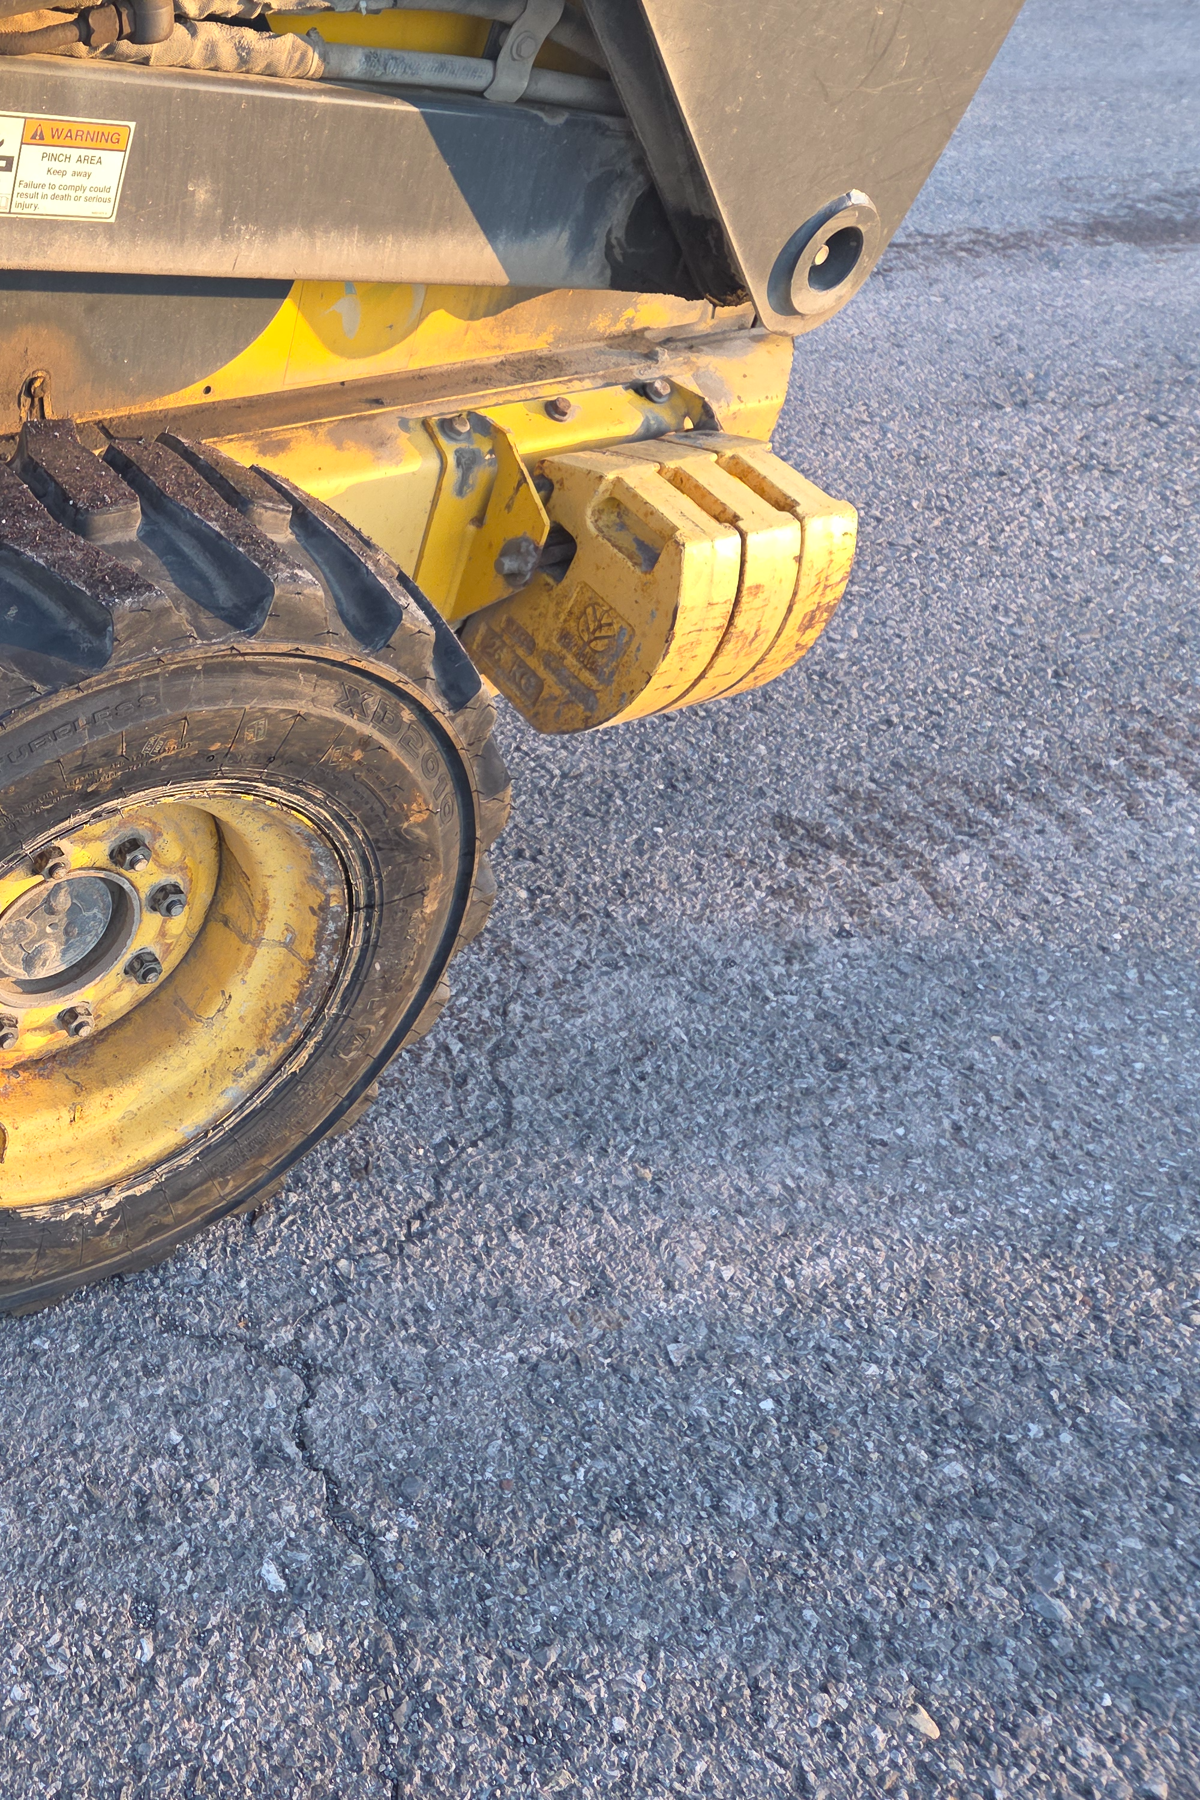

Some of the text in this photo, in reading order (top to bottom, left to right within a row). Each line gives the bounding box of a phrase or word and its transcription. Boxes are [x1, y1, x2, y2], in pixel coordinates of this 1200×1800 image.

[50, 127, 121, 145] WARNING
[41, 152, 103, 165] PINCH AREA
[46, 167, 92, 180] Keep away
[18, 180, 111, 194] Failure to comply could
[16, 191, 39, 200] result
[41, 192, 48, 200] in
[50, 193, 72, 201] death
[84, 195, 111, 204] serious
[14, 201, 40, 211] injury.
[333, 681, 455, 825] XD2010
